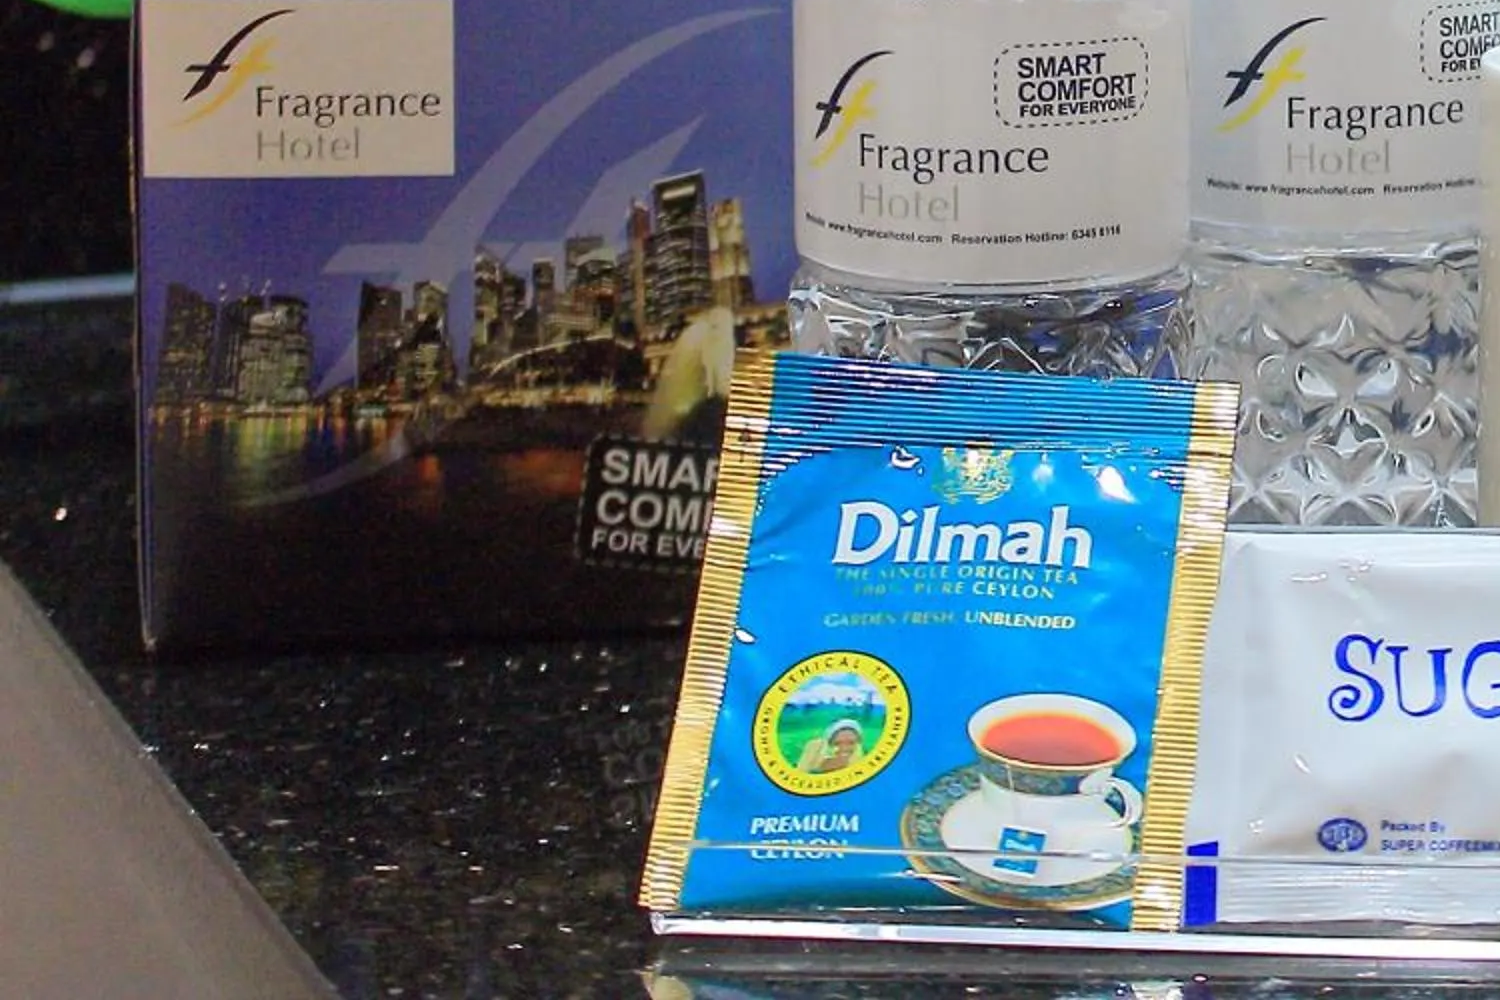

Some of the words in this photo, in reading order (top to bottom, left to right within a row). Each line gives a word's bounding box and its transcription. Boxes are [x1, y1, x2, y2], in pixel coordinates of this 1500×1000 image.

[1440, 12, 1500, 36] SMART
[1017, 53, 1106, 78] SMART
[1441, 59, 1467, 73] FOR
[1018, 73, 1137, 103] COMFORT
[256, 84, 442, 129] Fragrance
[1019, 102, 1054, 118] FOR
[1057, 96, 1137, 116] EVERYONE
[1287, 96, 1465, 142] Fragrance
[256, 127, 361, 161] Hotel
[858, 132, 1050, 185] Fragrance
[1286, 139, 1392, 176] Hotel
[857, 182, 960, 222] Hotel
[951, 232, 1023, 246] Reservation
[1025, 230, 1069, 244] Hotline:
[591, 528, 648, 555] FOR
[832, 501, 1093, 569] Dilmah
[957, 565, 1035, 582] ORIGIN
[1043, 570, 1079, 585] TEA
[913, 582, 965, 596] PURE
[972, 582, 1055, 600] CEYLON
[823, 611, 897, 628] GARDEN
[964, 610, 1077, 630] UNBLENDED
[874, 665, 899, 695] TEA
[751, 814, 861, 835] PREMIUM
[1380, 819, 1426, 833] Packed
[1380, 840, 1426, 852] SUPER
